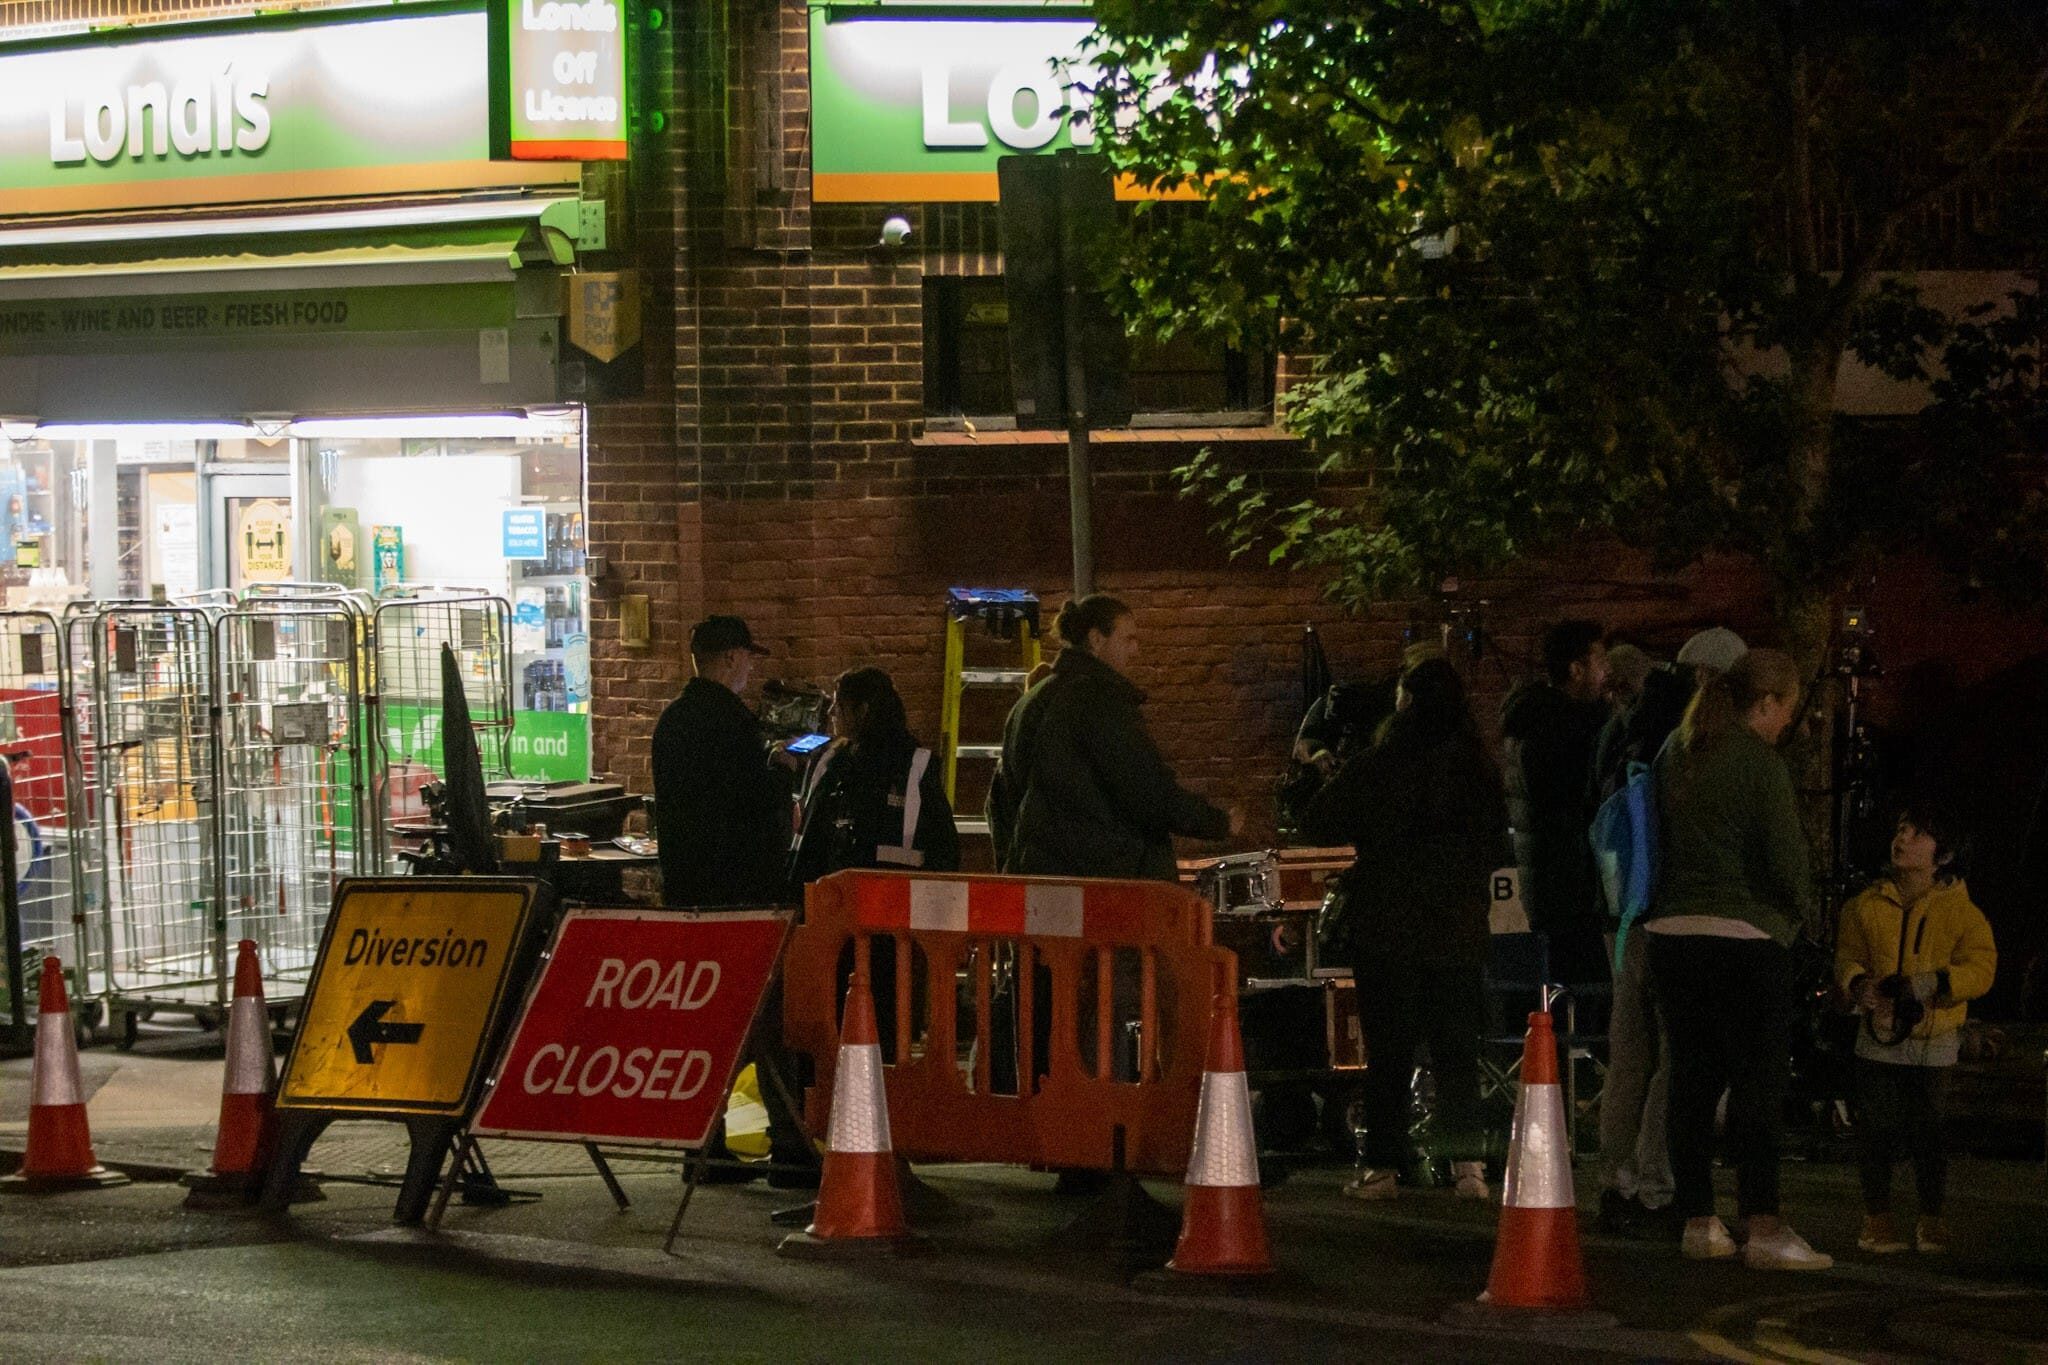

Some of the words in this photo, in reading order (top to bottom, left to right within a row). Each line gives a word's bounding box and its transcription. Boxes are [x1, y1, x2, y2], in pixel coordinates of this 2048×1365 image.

[523, 0, 616, 31] Londis
[553, 51, 597, 84] Off
[50, 62, 271, 162] Londis
[62, 309, 111, 331] WINE
[116, 307, 155, 329] AND
[161, 305, 208, 328] BEER
[225, 303, 289, 326] FRESH
[293, 301, 347, 324] FOOD
[508, 525, 538, 535] TOBACCO
[247, 560, 285, 570] DISTANCE
[512, 730, 528, 754] in
[533, 731, 568, 757] and
[1494, 876, 1513, 900] B
[344, 928, 488, 968] Diversion
[585, 958, 721, 1010] ROAD
[523, 1043, 712, 1100] CLOSED
